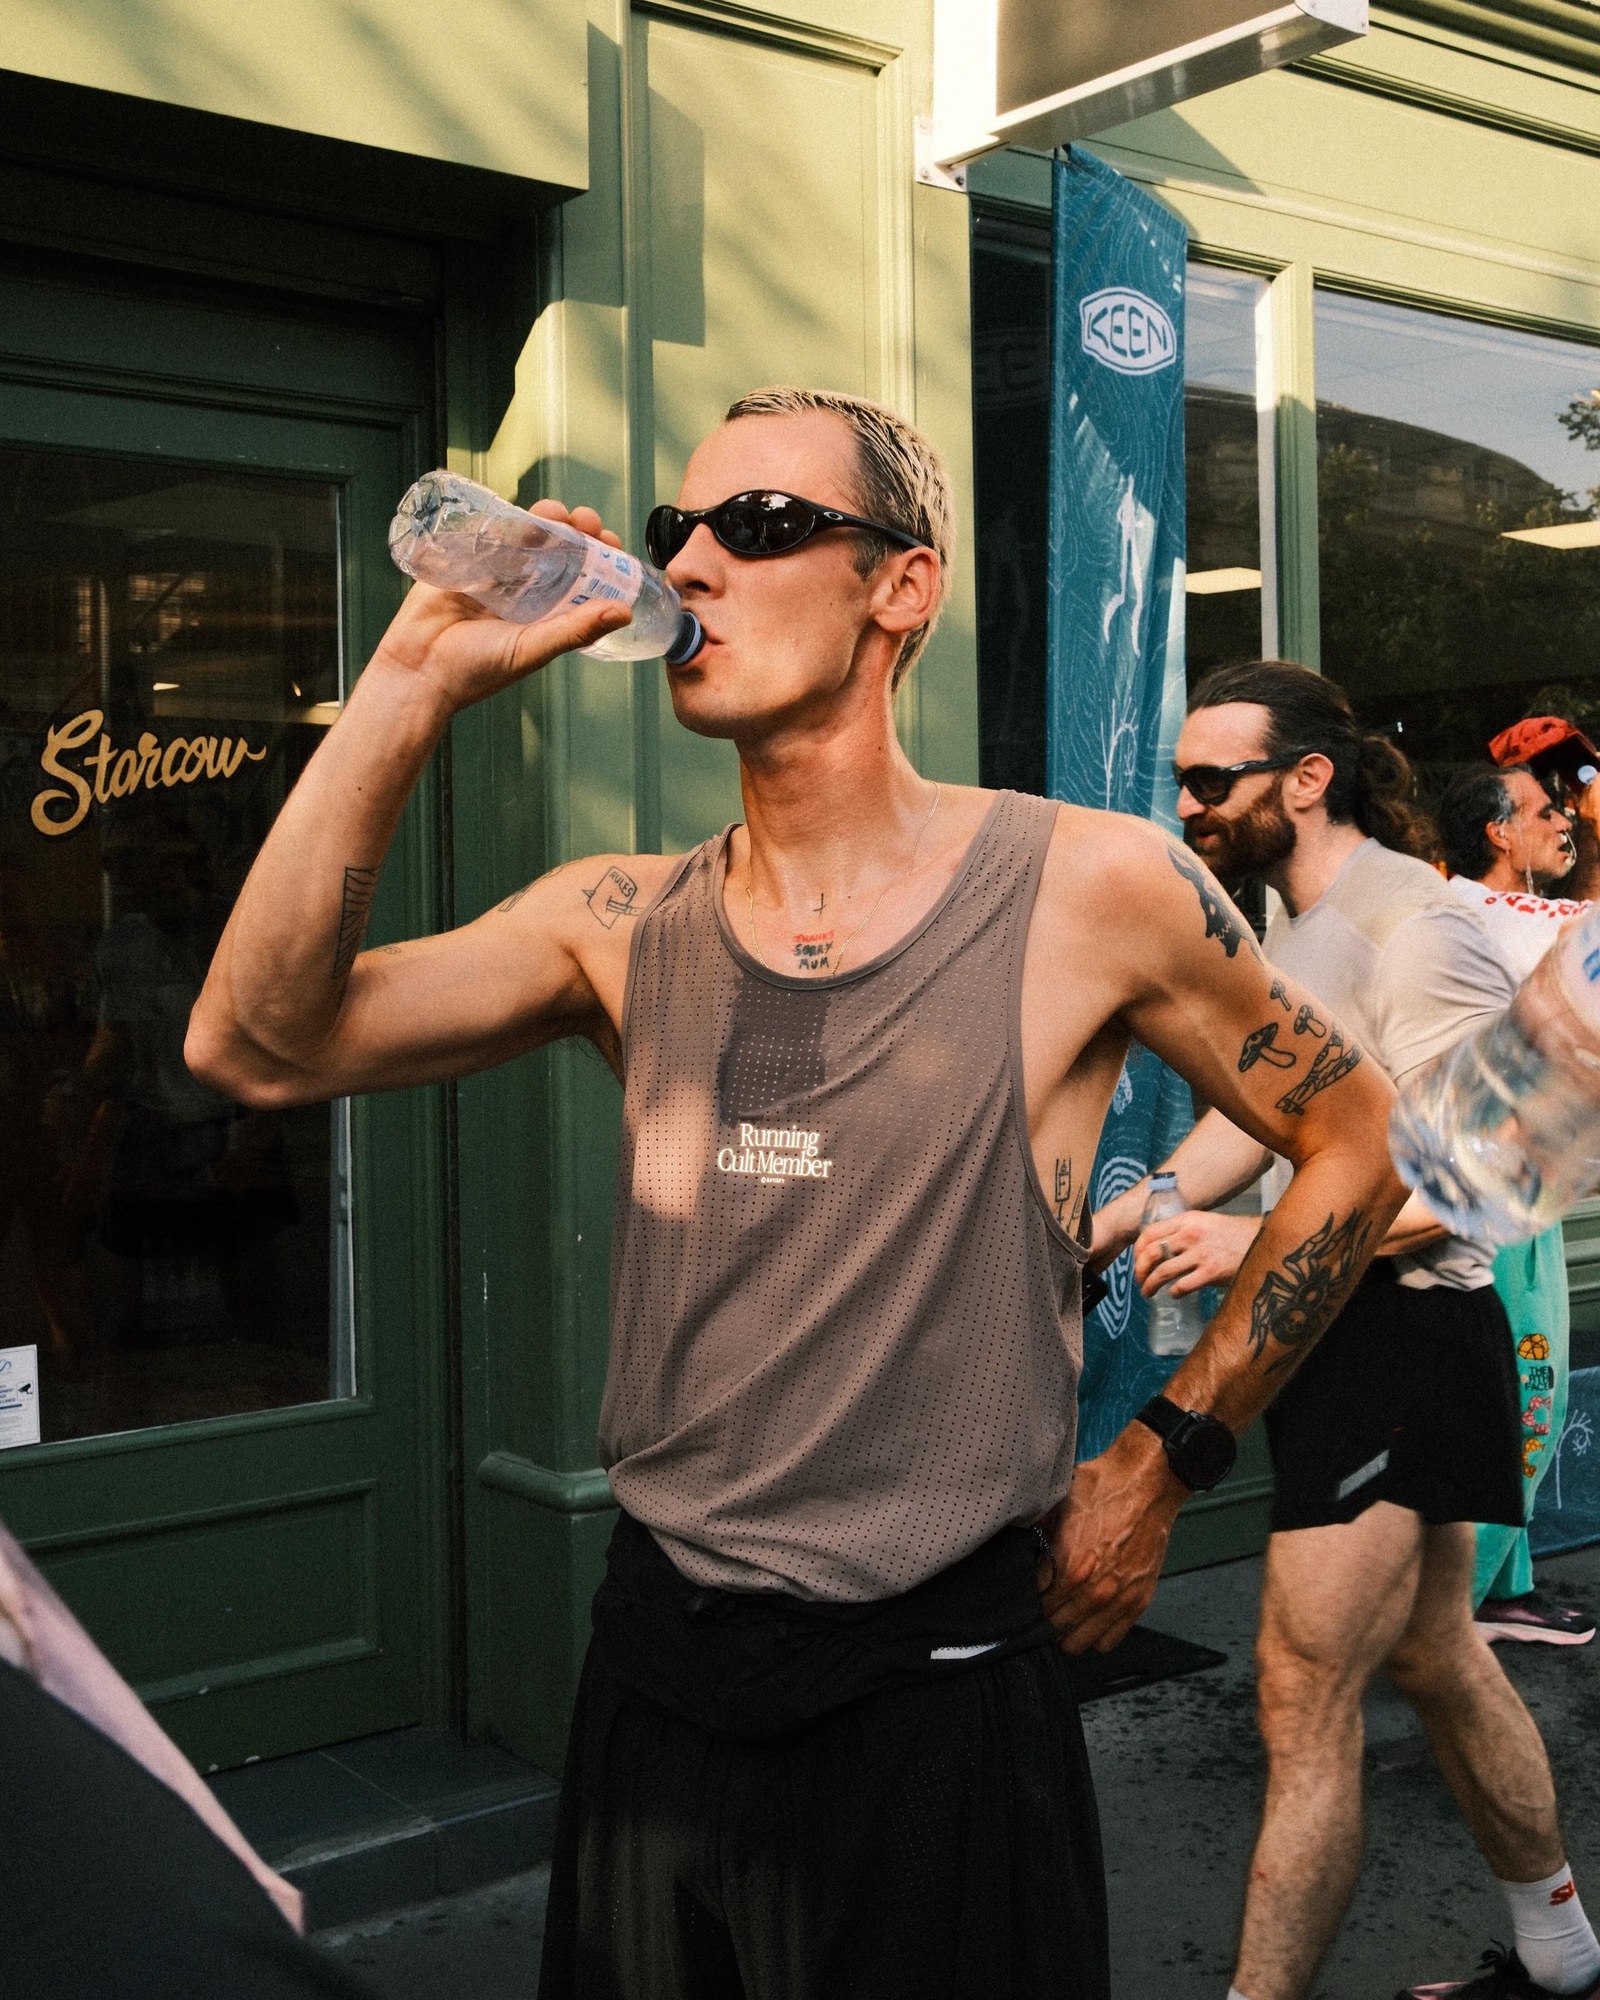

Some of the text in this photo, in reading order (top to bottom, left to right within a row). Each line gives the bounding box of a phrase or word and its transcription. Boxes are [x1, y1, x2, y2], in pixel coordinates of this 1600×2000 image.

[1086, 303, 1169, 360] KEEN
[30, 708, 267, 836] Starcow
[609, 871, 634, 898] RULES
[739, 1123, 820, 1157] Running
[717, 1148, 833, 1178] Cult Member
[1529, 1366, 1549, 1376] THE
